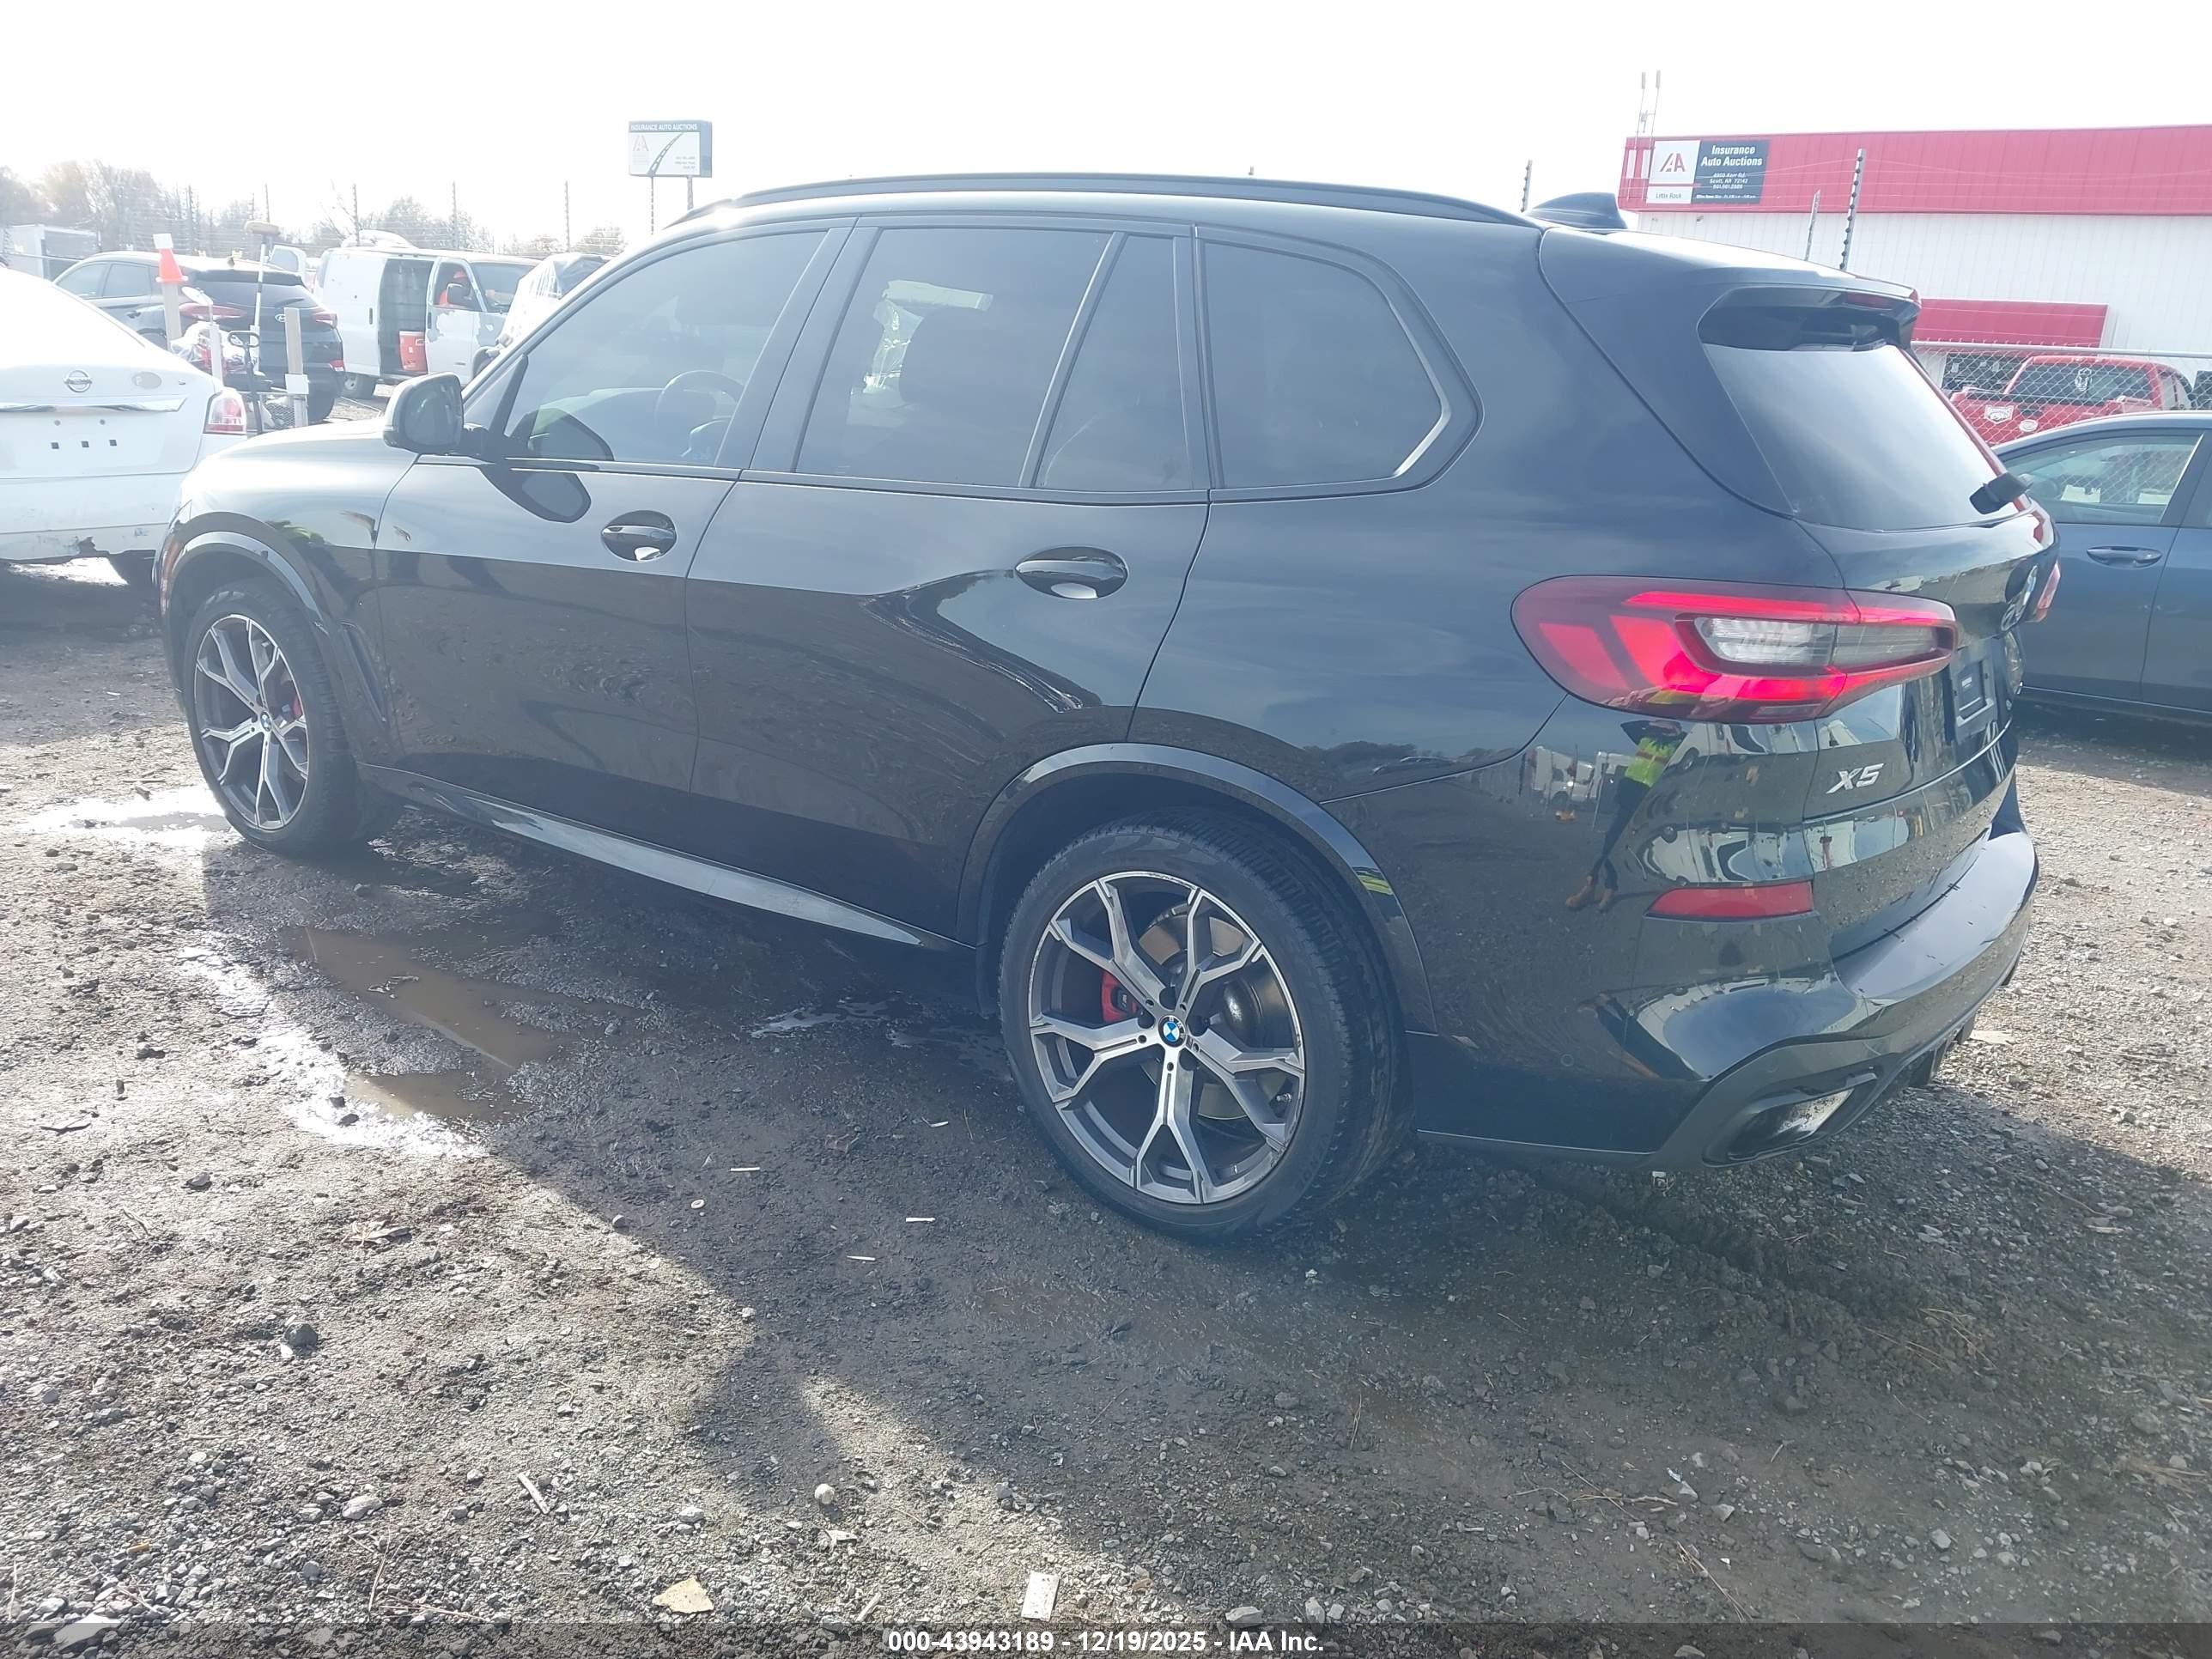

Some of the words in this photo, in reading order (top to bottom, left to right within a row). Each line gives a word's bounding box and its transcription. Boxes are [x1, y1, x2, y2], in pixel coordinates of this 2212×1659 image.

[1711, 144, 1756, 155] Insurance
[1700, 155, 1722, 167] Auto
[1723, 155, 1763, 167] Auctions
[1826, 763, 1885, 794] X5
